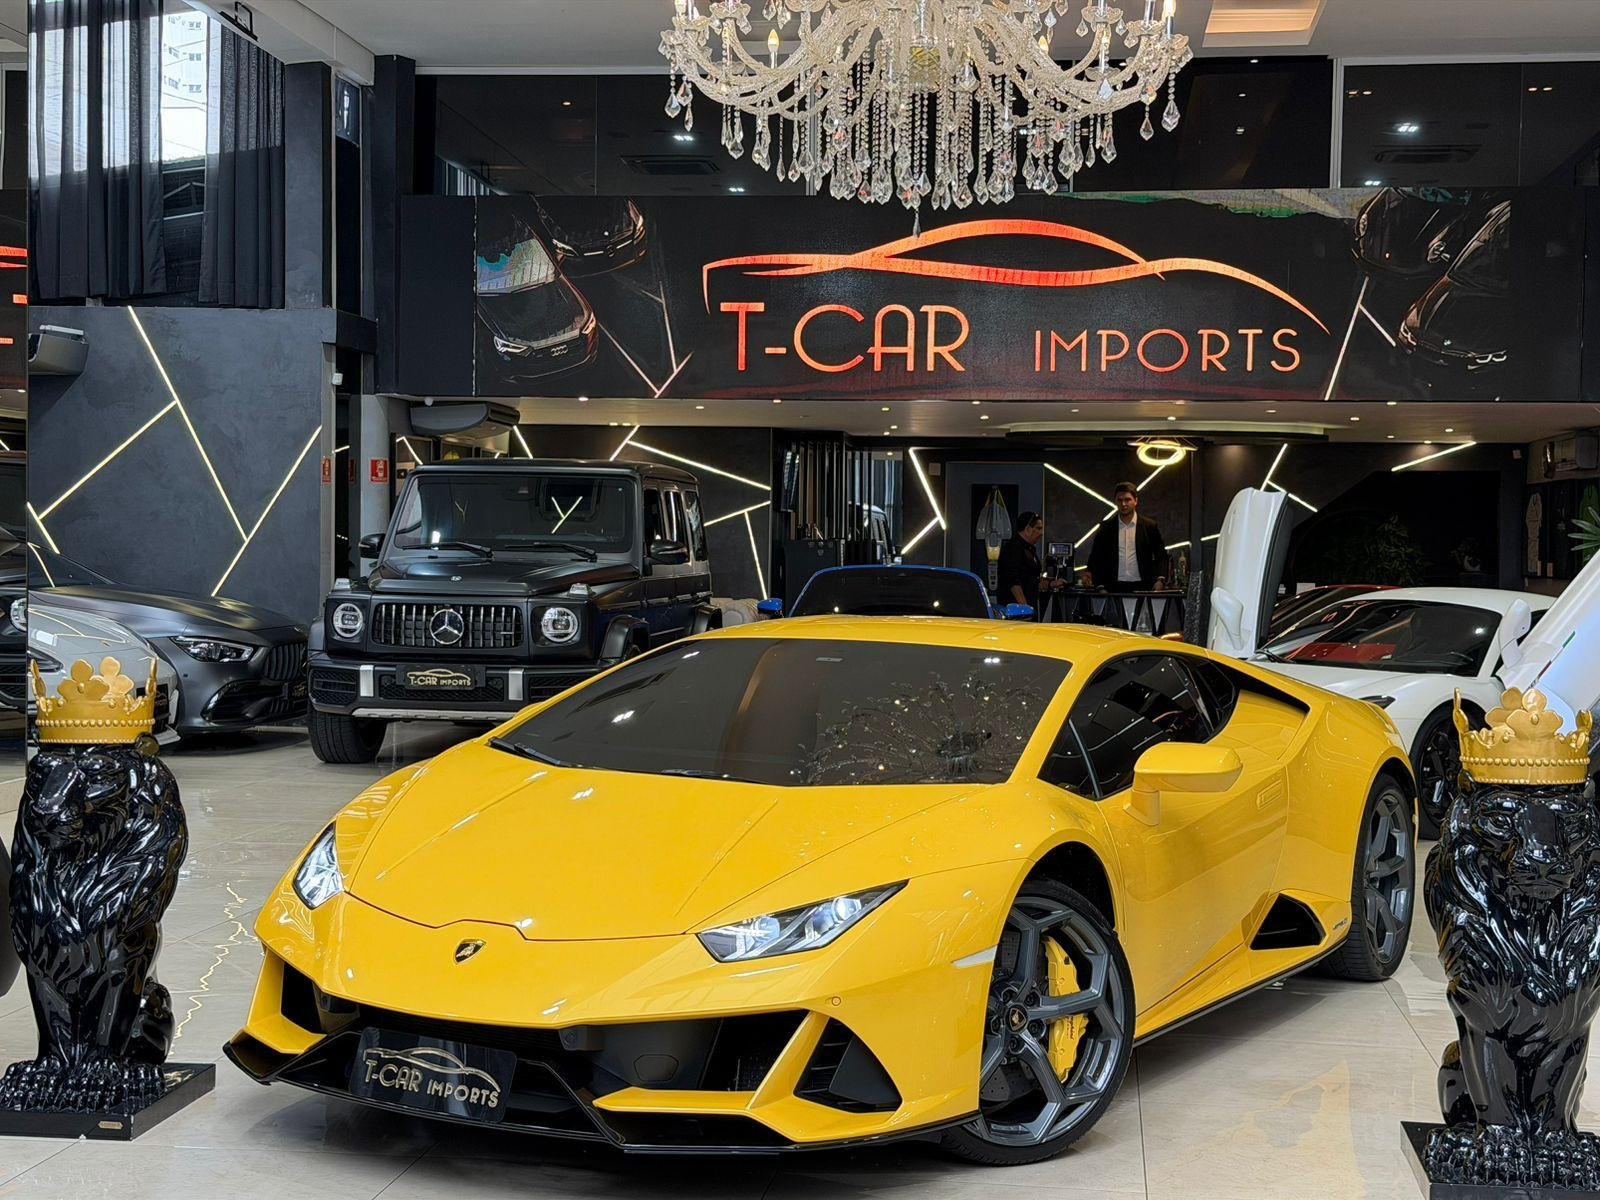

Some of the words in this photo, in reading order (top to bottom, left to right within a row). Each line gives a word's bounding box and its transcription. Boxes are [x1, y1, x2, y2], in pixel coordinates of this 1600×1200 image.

[719, 301, 970, 373] T-CAR
[1034, 328, 1301, 373] IMPORTS
[409, 677, 438, 685] T-CAR
[365, 1059, 424, 1092] T-CAR
[427, 1078, 499, 1108] IMPORTS
